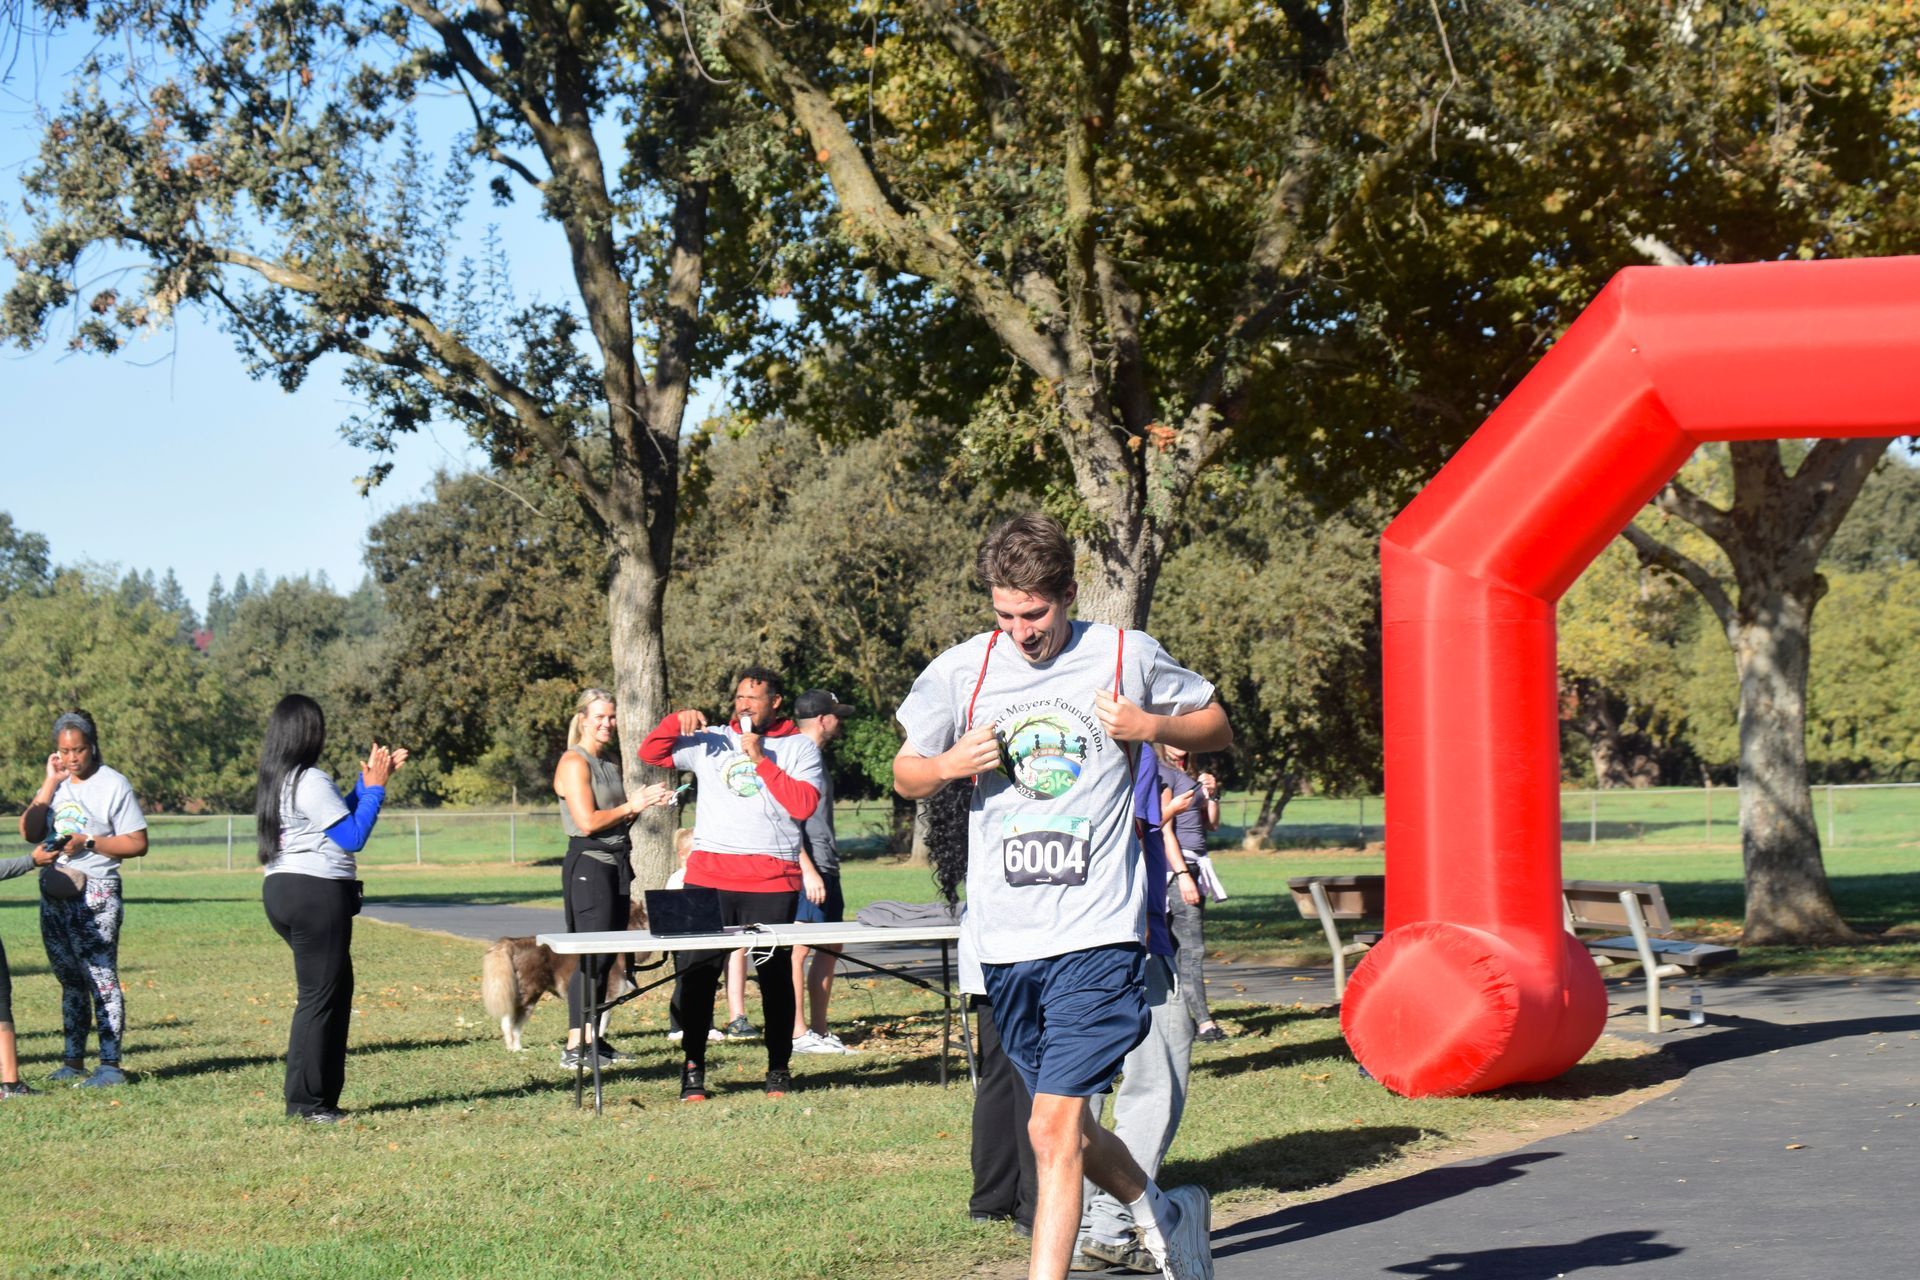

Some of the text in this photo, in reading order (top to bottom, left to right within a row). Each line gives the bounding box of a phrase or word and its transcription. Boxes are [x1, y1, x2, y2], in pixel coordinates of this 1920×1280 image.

[1005, 697, 1104, 753] Meyers Foundation
[1016, 784, 1036, 799] 2025
[1038, 770, 1071, 793] 5K
[1005, 839, 1086, 874] 6004
